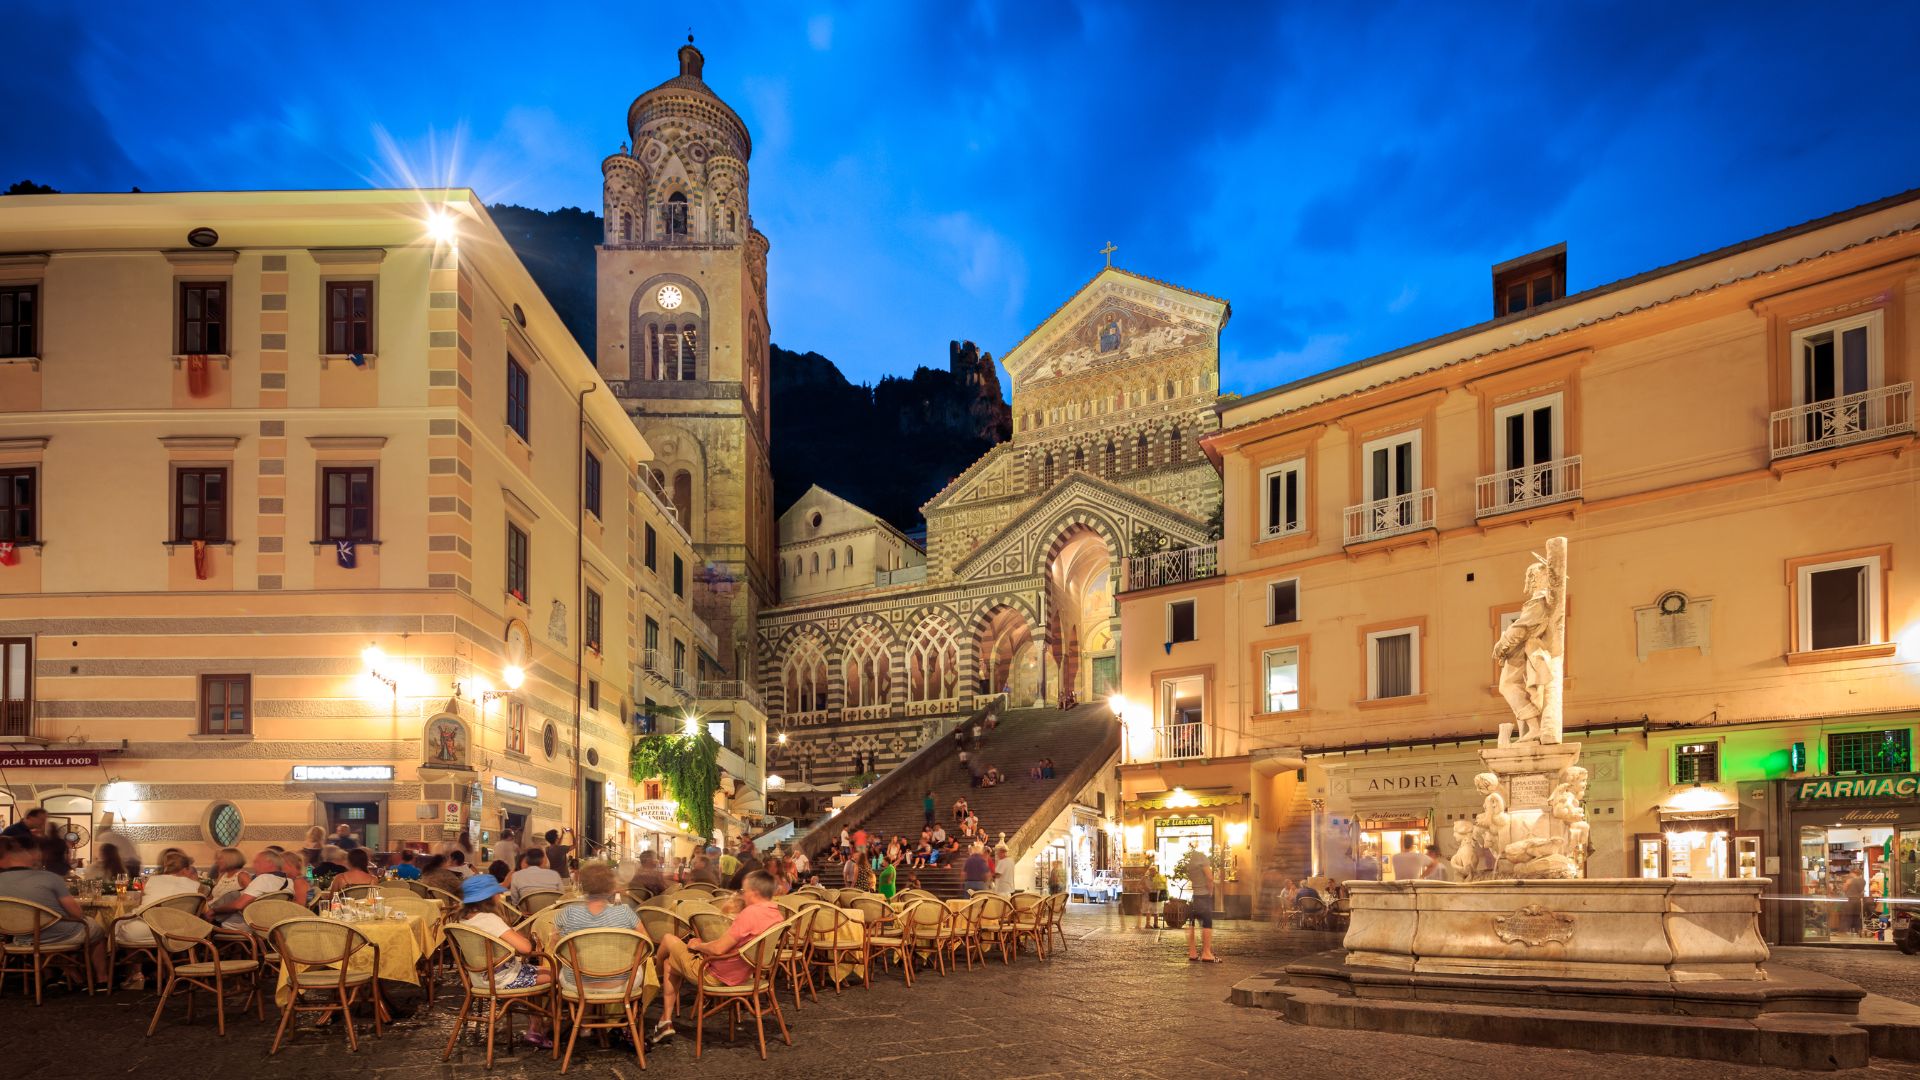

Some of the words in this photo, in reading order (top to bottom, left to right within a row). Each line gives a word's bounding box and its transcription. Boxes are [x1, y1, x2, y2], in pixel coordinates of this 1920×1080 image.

[0, 758, 26, 766] OCAL
[28, 758, 64, 766] TYPICAL
[66, 757, 91, 765] FOOD
[1368, 773, 1459, 791] ANDREA
[636, 804, 674, 812] RISTORAN
[1839, 808, 1901, 822] Medaglia
[1172, 817, 1208, 826] Limoncello
